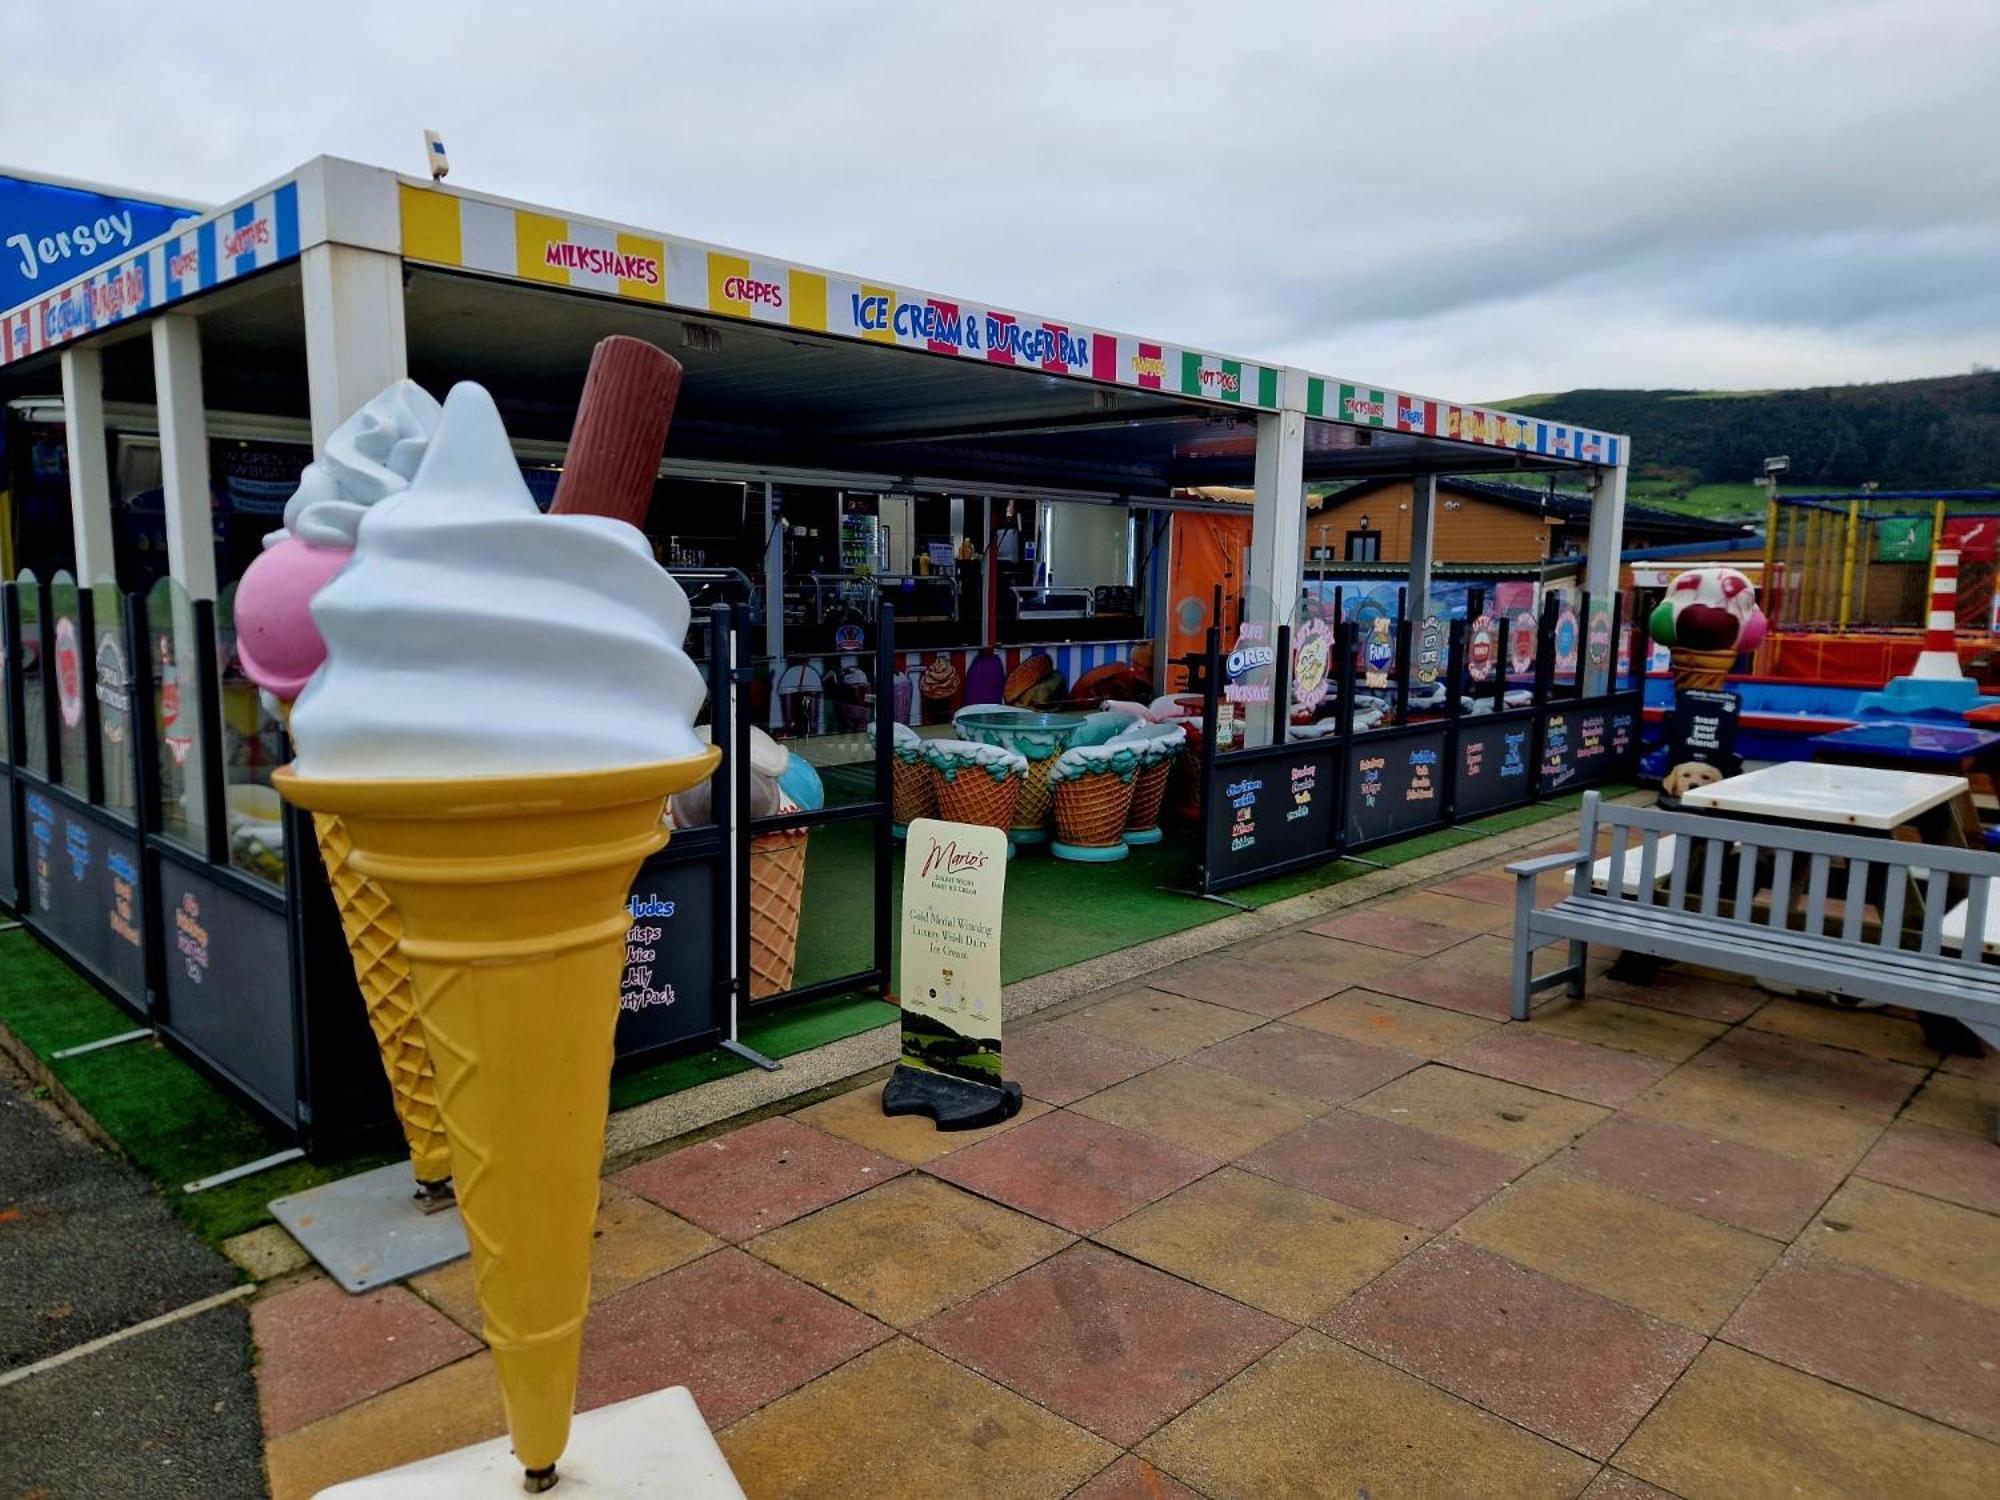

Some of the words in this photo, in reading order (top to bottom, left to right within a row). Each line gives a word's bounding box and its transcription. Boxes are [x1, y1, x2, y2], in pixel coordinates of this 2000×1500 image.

[6, 210, 133, 280] Jersey
[545, 241, 659, 285] MILKSHAKES
[724, 275, 782, 307] CREPES
[851, 293, 889, 331] ICE
[893, 302, 962, 347] CREAM
[965, 315, 980, 351] &
[986, 315, 1055, 363] BURGER
[1057, 331, 1088, 367] BAR
[1215, 370, 1239, 392] DOGS
[1227, 646, 1273, 676] OREO
[1370, 643, 1392, 661] FANTA
[920, 836, 989, 878] Mario's
[909, 909, 929, 923] Gold
[931, 912, 956, 927] Medal
[957, 917, 993, 938] Winning
[912, 925, 938, 941] Luxury
[941, 930, 964, 944] Welsh
[966, 935, 988, 952] Dairy
[930, 942, 941, 953] Ice
[942, 945, 967, 960] Cream
[621, 966, 652, 988] Jelly
[643, 984, 675, 1009] Pack
